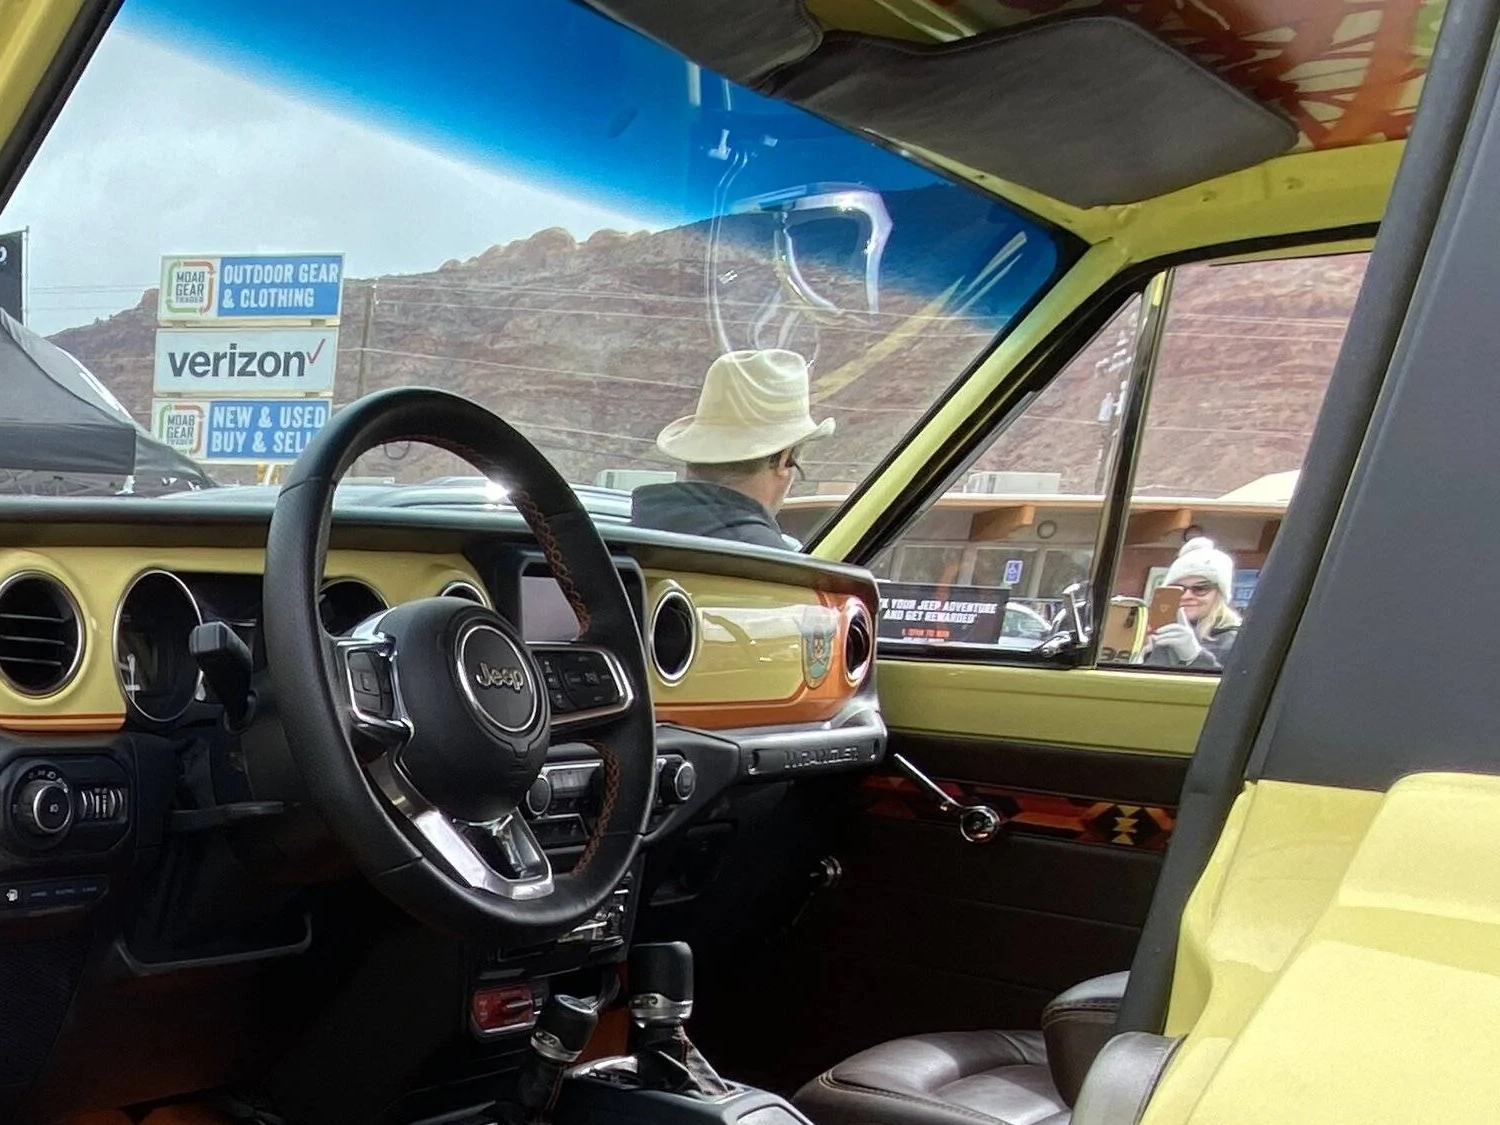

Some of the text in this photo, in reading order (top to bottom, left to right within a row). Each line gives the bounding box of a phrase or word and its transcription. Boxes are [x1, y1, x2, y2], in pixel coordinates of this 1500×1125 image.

[176, 271, 205, 282] MOAB
[224, 263, 339, 284] OUTDOOR GEAR
[176, 284, 204, 296] GEAR
[222, 288, 314, 308] & CLOTHING
[168, 343, 305, 377] verizon
[167, 414, 195, 425] MOAB
[213, 406, 325, 428] NEW & USED
[167, 427, 194, 438] GEAR
[212, 431, 247, 453] BUY
[252, 431, 267, 452] &
[883, 609, 904, 620] AND
[905, 610, 924, 621] GET
[891, 598, 917, 610] YOUR
[917, 599, 942, 611] JEEP
[942, 601, 998, 614] ADVENTURE
[476, 662, 525, 692] Jeep
